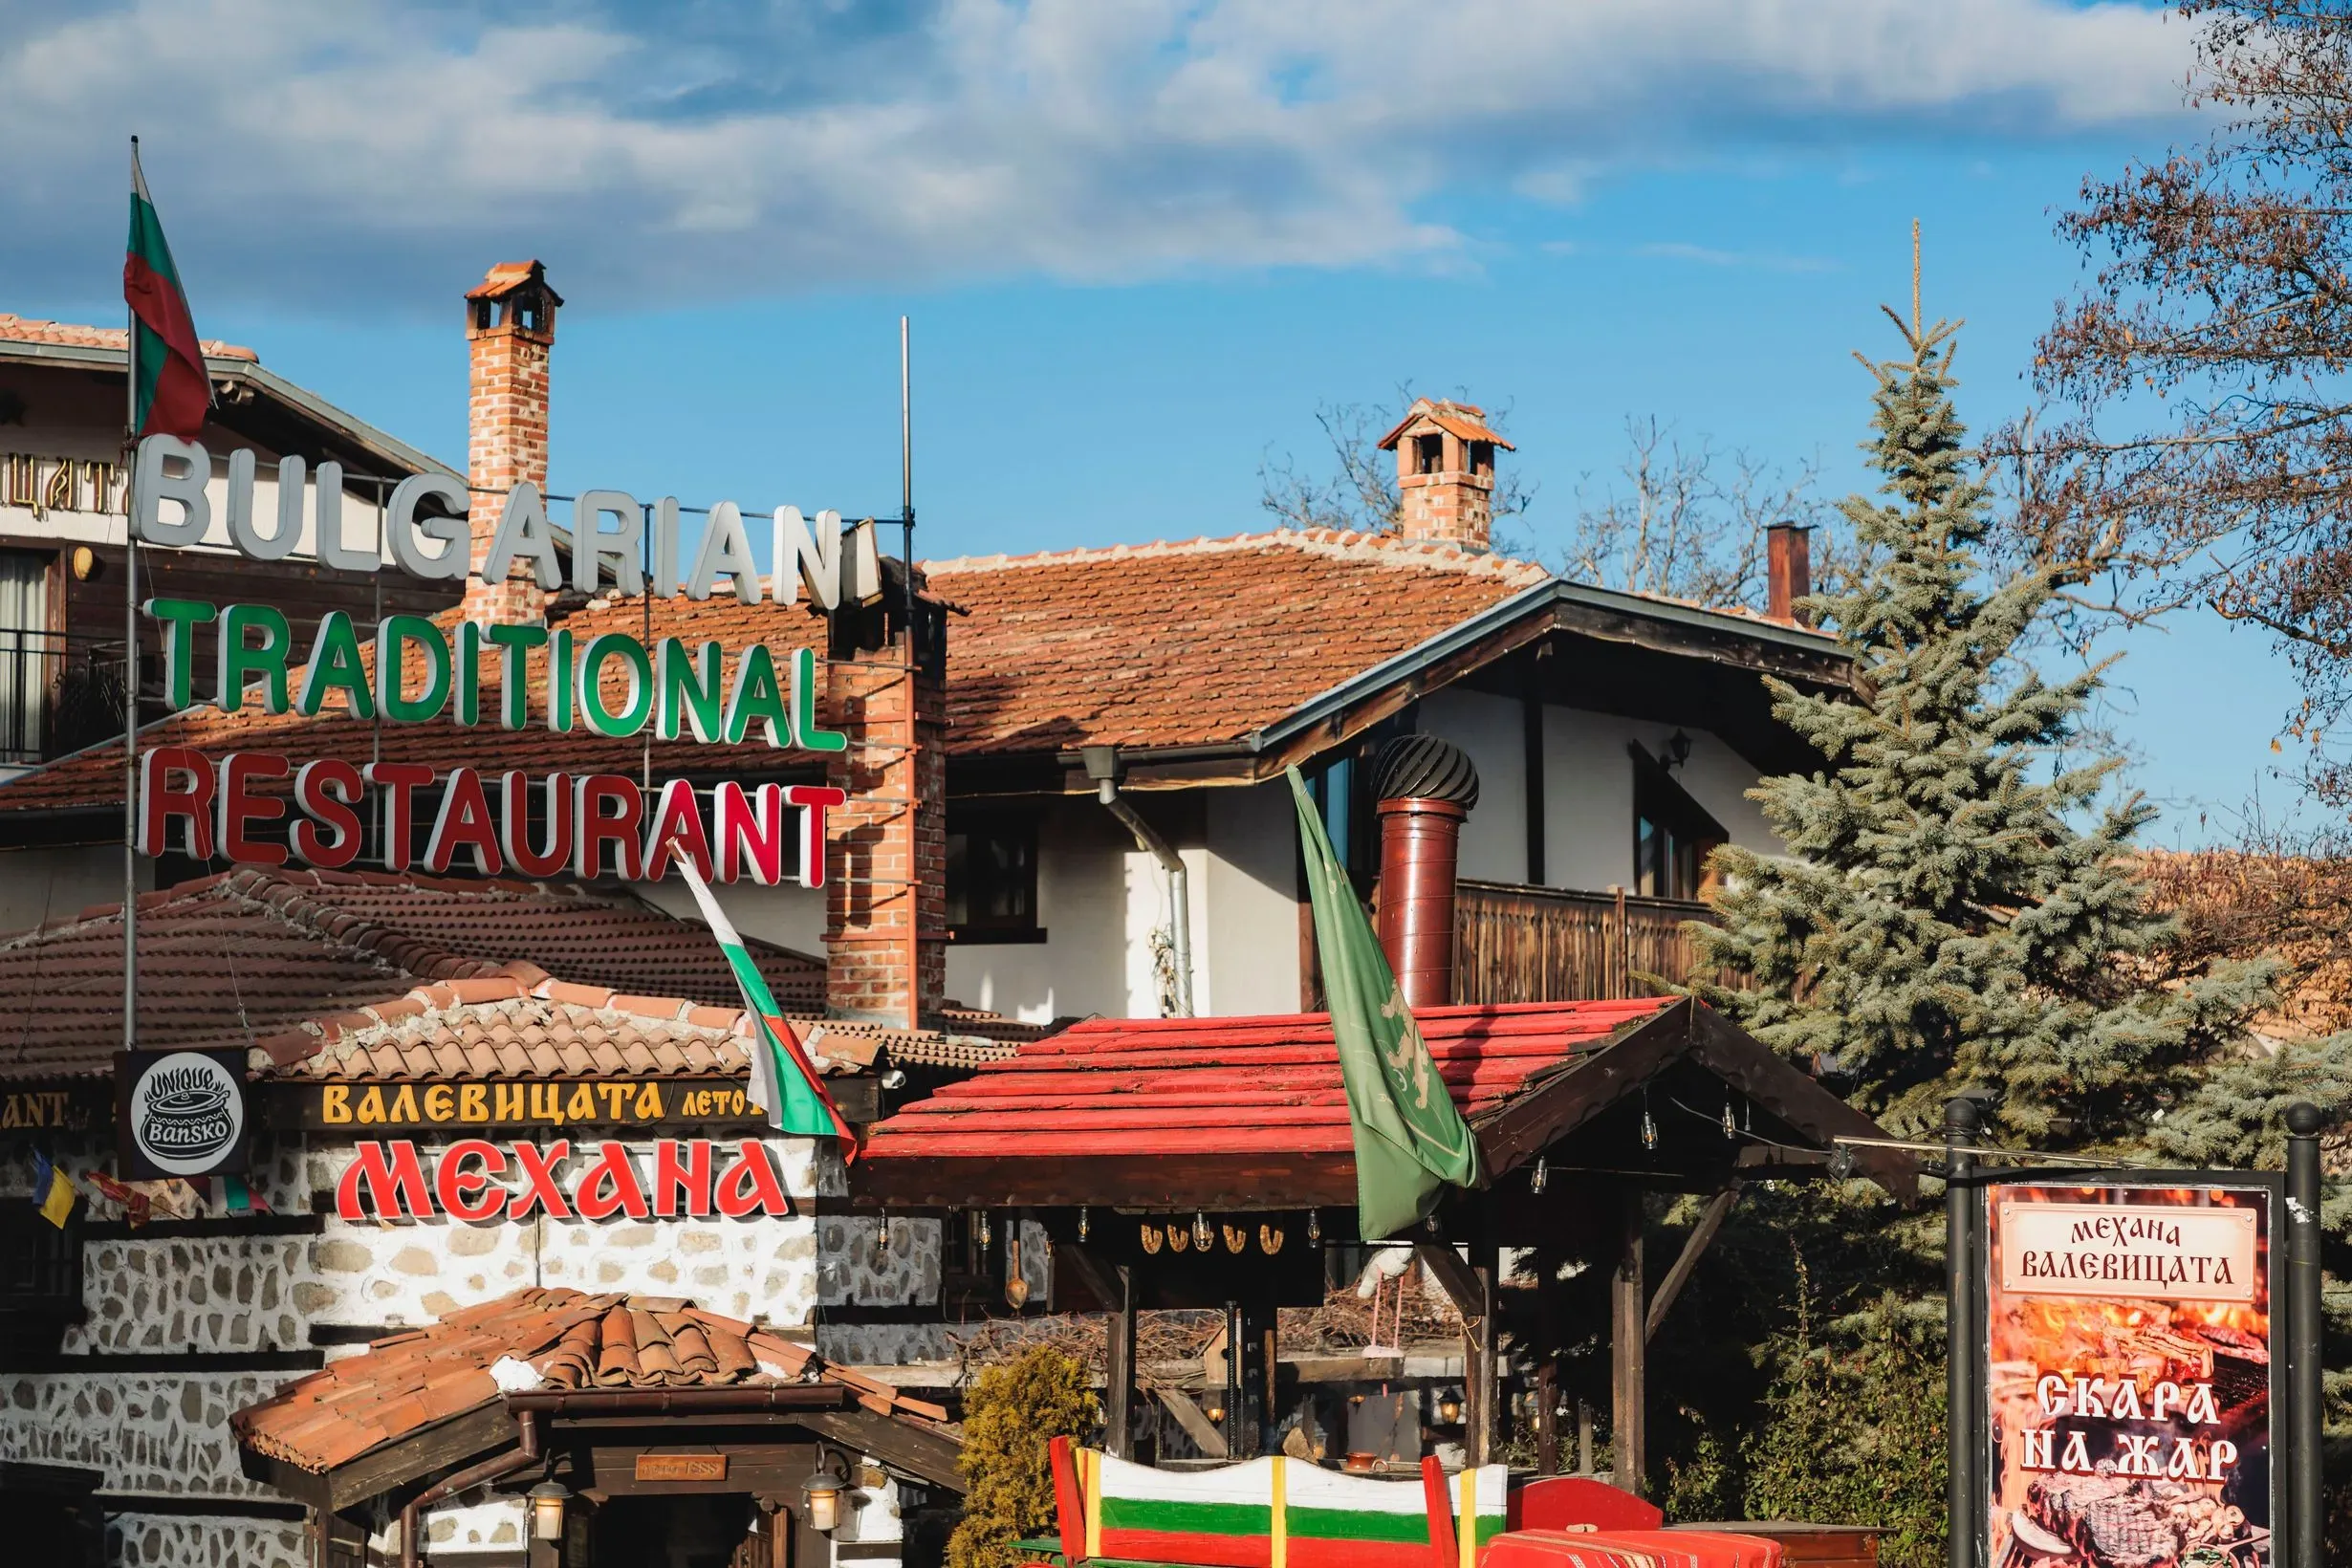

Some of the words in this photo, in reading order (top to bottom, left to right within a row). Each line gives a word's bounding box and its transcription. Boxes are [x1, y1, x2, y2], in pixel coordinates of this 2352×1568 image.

[132, 434, 841, 610] BULGARIAN
[142, 598, 847, 752] TRADITIONAL
[138, 747, 845, 888] RESTAURANT
[322, 1082, 664, 1125] ВАЛЕВИЦАТА
[682, 1090, 745, 1116] ЛЕТО
[336, 1138, 789, 1221] МЕХАНА
[2071, 1216, 2181, 1247] МЕХАНА
[2020, 1251, 2234, 1290] ВАЛЕВИЦАТА
[2036, 1371, 2221, 1425] СКАРА
[2020, 1428, 2095, 1472] НА
[2114, 1435, 2237, 1482] ЖАР
